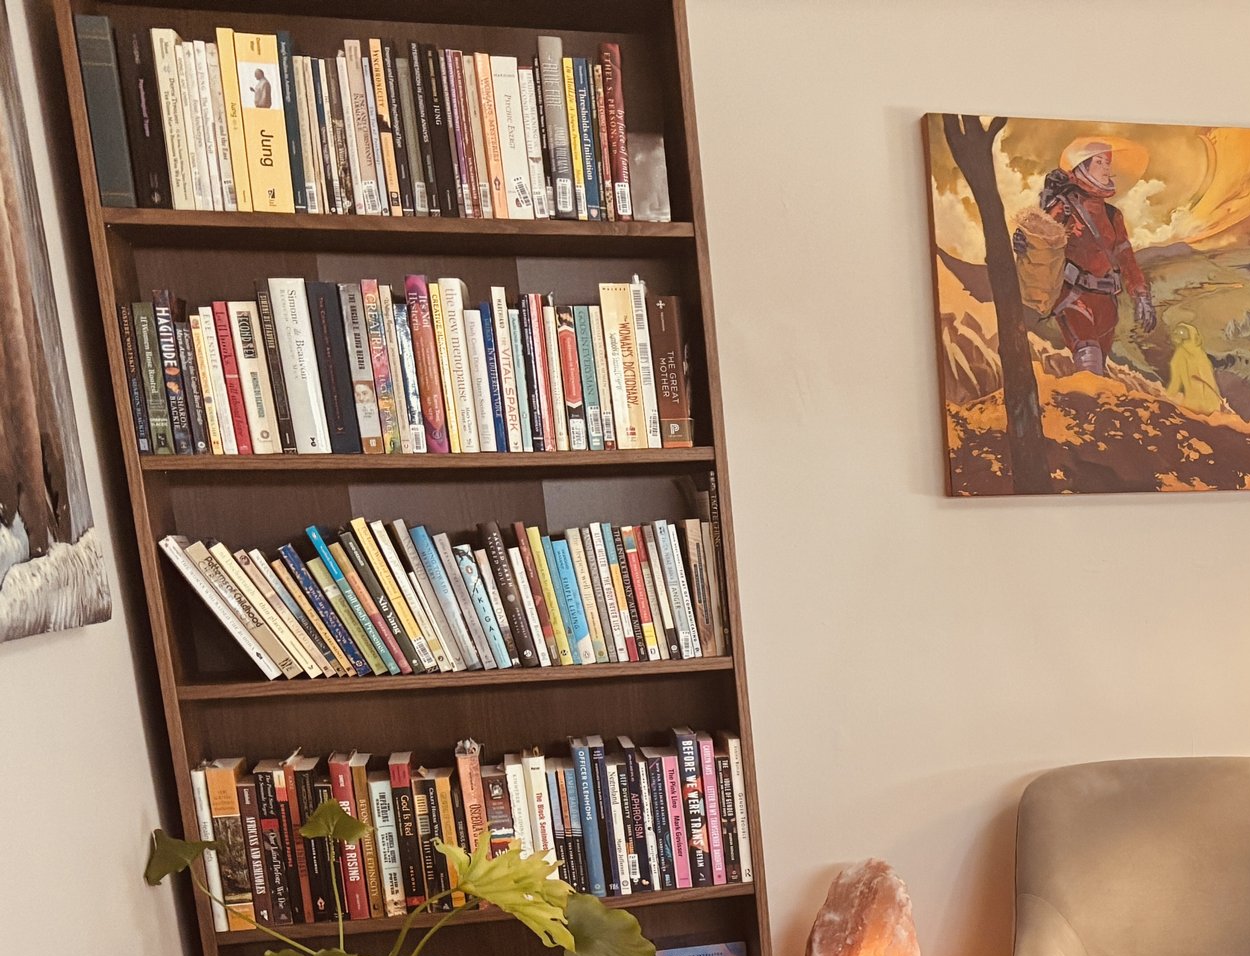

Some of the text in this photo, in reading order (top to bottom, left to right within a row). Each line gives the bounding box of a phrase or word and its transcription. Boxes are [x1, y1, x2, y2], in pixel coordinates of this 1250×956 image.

[603, 52, 612, 82] ETHEL
[432, 105, 442, 125] JUNG
[617, 109, 624, 120] by
[260, 129, 276, 167] Jung
[578, 87, 593, 180] Thresholds of Initiation
[618, 122, 626, 143] force
[620, 146, 627, 155] of
[287, 289, 299, 324] Simone
[407, 292, 419, 330] Hysteria
[420, 311, 429, 327] Not
[141, 324, 151, 350] Women
[155, 306, 177, 366] HAGITUDE
[364, 293, 382, 359] CREATRIX
[145, 351, 154, 368] Rose
[444, 288, 467, 401] the new menopause
[147, 369, 157, 393] Rooted
[500, 347, 518, 430] VITAL SPARK
[658, 357, 669, 397] MOTHER
[667, 351, 679, 403] THE GREAT
[177, 396, 187, 428] SHARON
[232, 591, 263, 628] Childhood
[671, 586, 681, 609] ANGER
[344, 588, 386, 654] Full Body Presence
[376, 594, 402, 635] Xiu Yang
[578, 750, 591, 820] OFFICER CLEMMONS
[608, 771, 619, 805] Negroland
[681, 740, 701, 845] BEFORE WE WERE TRANS
[400, 794, 409, 811] God
[631, 792, 642, 838] APHRO-ISM
[245, 816, 258, 845] AFRICANS
[404, 822, 412, 836] Red
[535, 792, 548, 850] The Black Seminoles
[250, 847, 260, 859] AND
[270, 846, 278, 863] Land
[346, 853, 359, 881] RISING
[273, 864, 281, 884] Before
[276, 886, 283, 895] We
[366, 857, 376, 897] ETHNICITY
